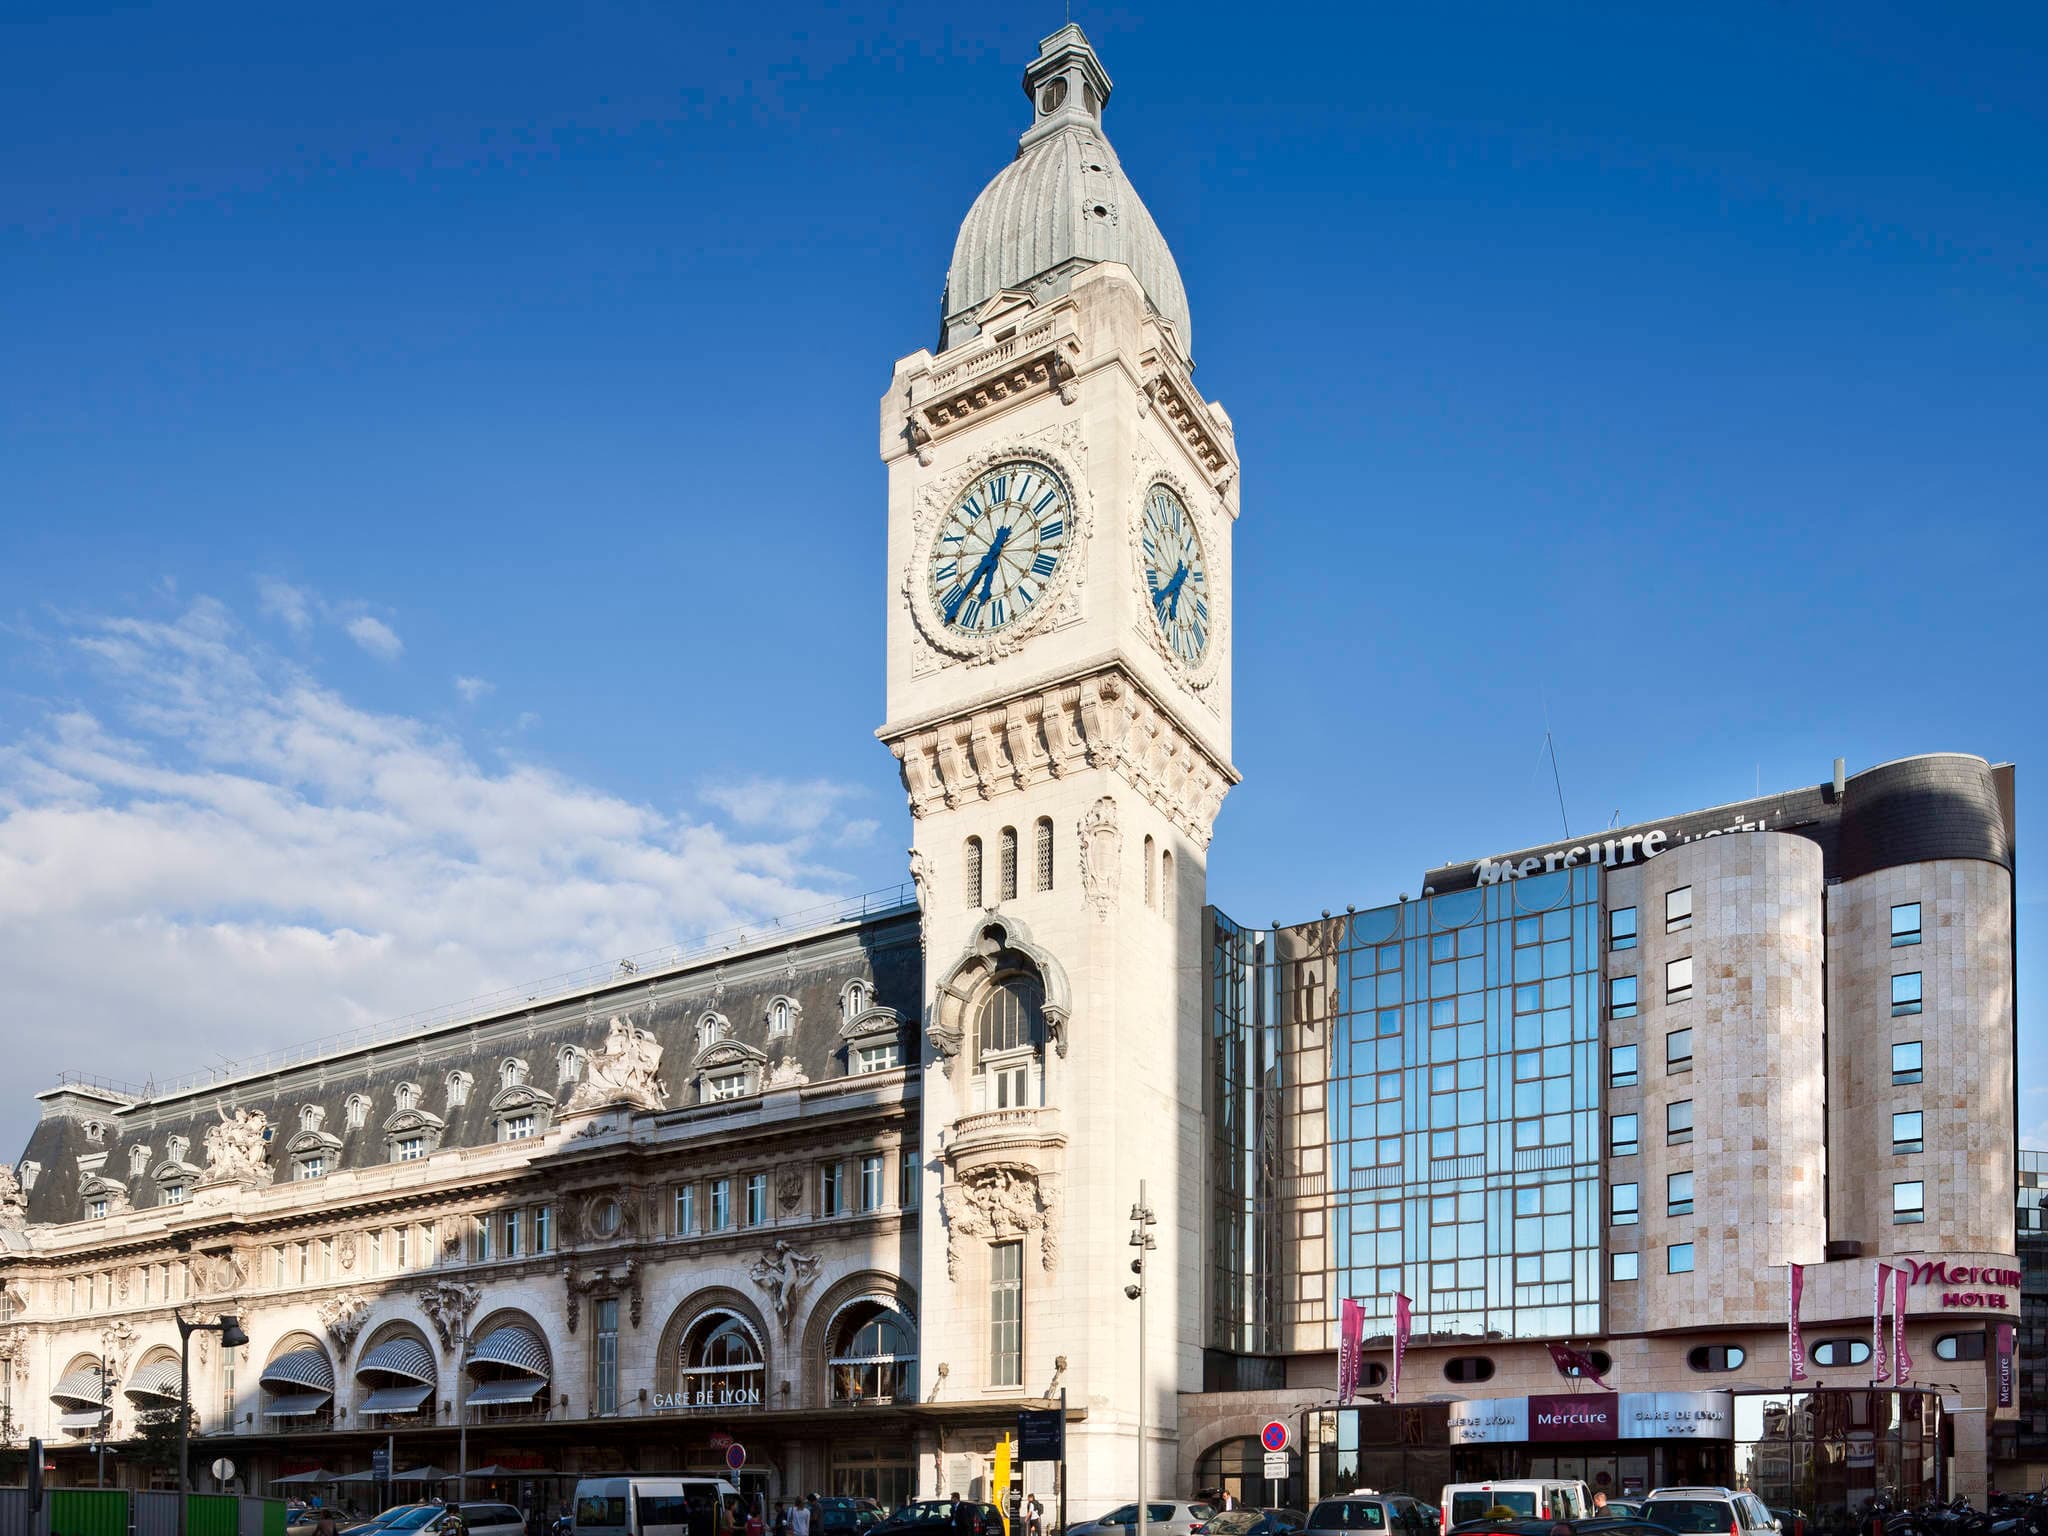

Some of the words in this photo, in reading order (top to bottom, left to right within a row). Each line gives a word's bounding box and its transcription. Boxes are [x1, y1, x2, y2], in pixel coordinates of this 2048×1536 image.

[990, 476, 1006, 504] XII
[1018, 474, 1032, 502] I
[962, 496, 982, 523] XI
[1033, 489, 1057, 516] II
[942, 531, 965, 547] X
[1040, 520, 1063, 542] III
[936, 560, 957, 582] IX
[1031, 553, 1058, 577] IIII
[1018, 585, 1034, 608] V
[960, 600, 981, 629] VII
[992, 599, 1005, 627] VI
[1943, 1292, 2009, 1309] HOTEL
[2000, 1358, 2009, 1402] Mercure
[653, 1391, 690, 1408] GARE
[696, 1390, 714, 1405] DE
[720, 1388, 760, 1404] LYON
[1485, 1415, 1516, 1426] LYON
[1537, 1412, 1607, 1425] Mercure
[1635, 1411, 1670, 1421] GARE
[1674, 1410, 1692, 1420] DE
[1695, 1410, 1725, 1422] LYON
